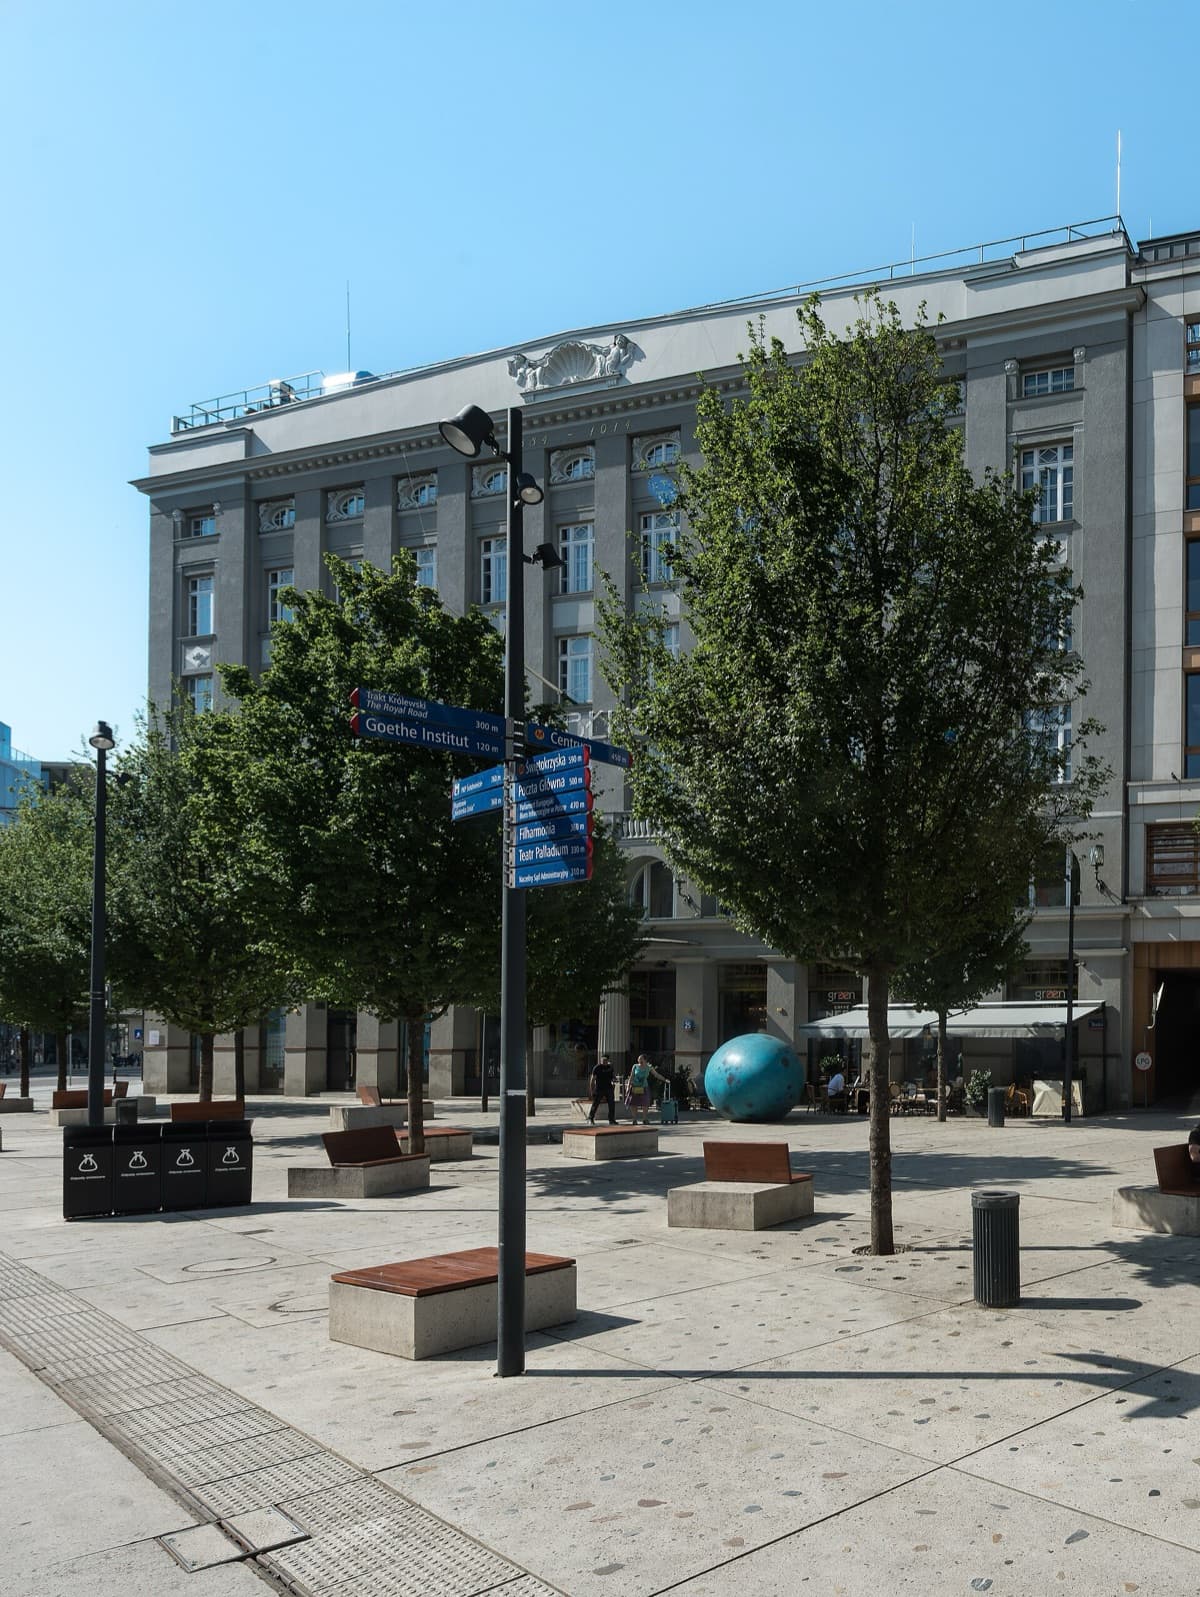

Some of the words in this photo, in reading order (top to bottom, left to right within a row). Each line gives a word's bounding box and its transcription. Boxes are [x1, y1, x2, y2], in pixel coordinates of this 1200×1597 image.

[366, 690, 386, 701] Trakt
[388, 694, 427, 710] Królewski
[366, 700, 382, 710] The
[384, 702, 406, 715] Royal
[408, 706, 429, 718] Road
[365, 717, 418, 739] Goethe
[422, 727, 470, 749] Institut
[476, 742, 490, 752] 120
[475, 720, 490, 731] 300
[491, 725, 499, 733] m
[525, 753, 567, 776] Świętokrzyska
[519, 783, 538, 799] Poczta
[540, 776, 566, 793] Główna
[519, 822, 556, 841] Filharmonia
[519, 848, 534, 862] Teatr
[535, 844, 569, 860] Palladium
[827, 991, 856, 1002] green
[1034, 990, 1066, 1001] green
[1136, 1057, 1150, 1065] LPG
